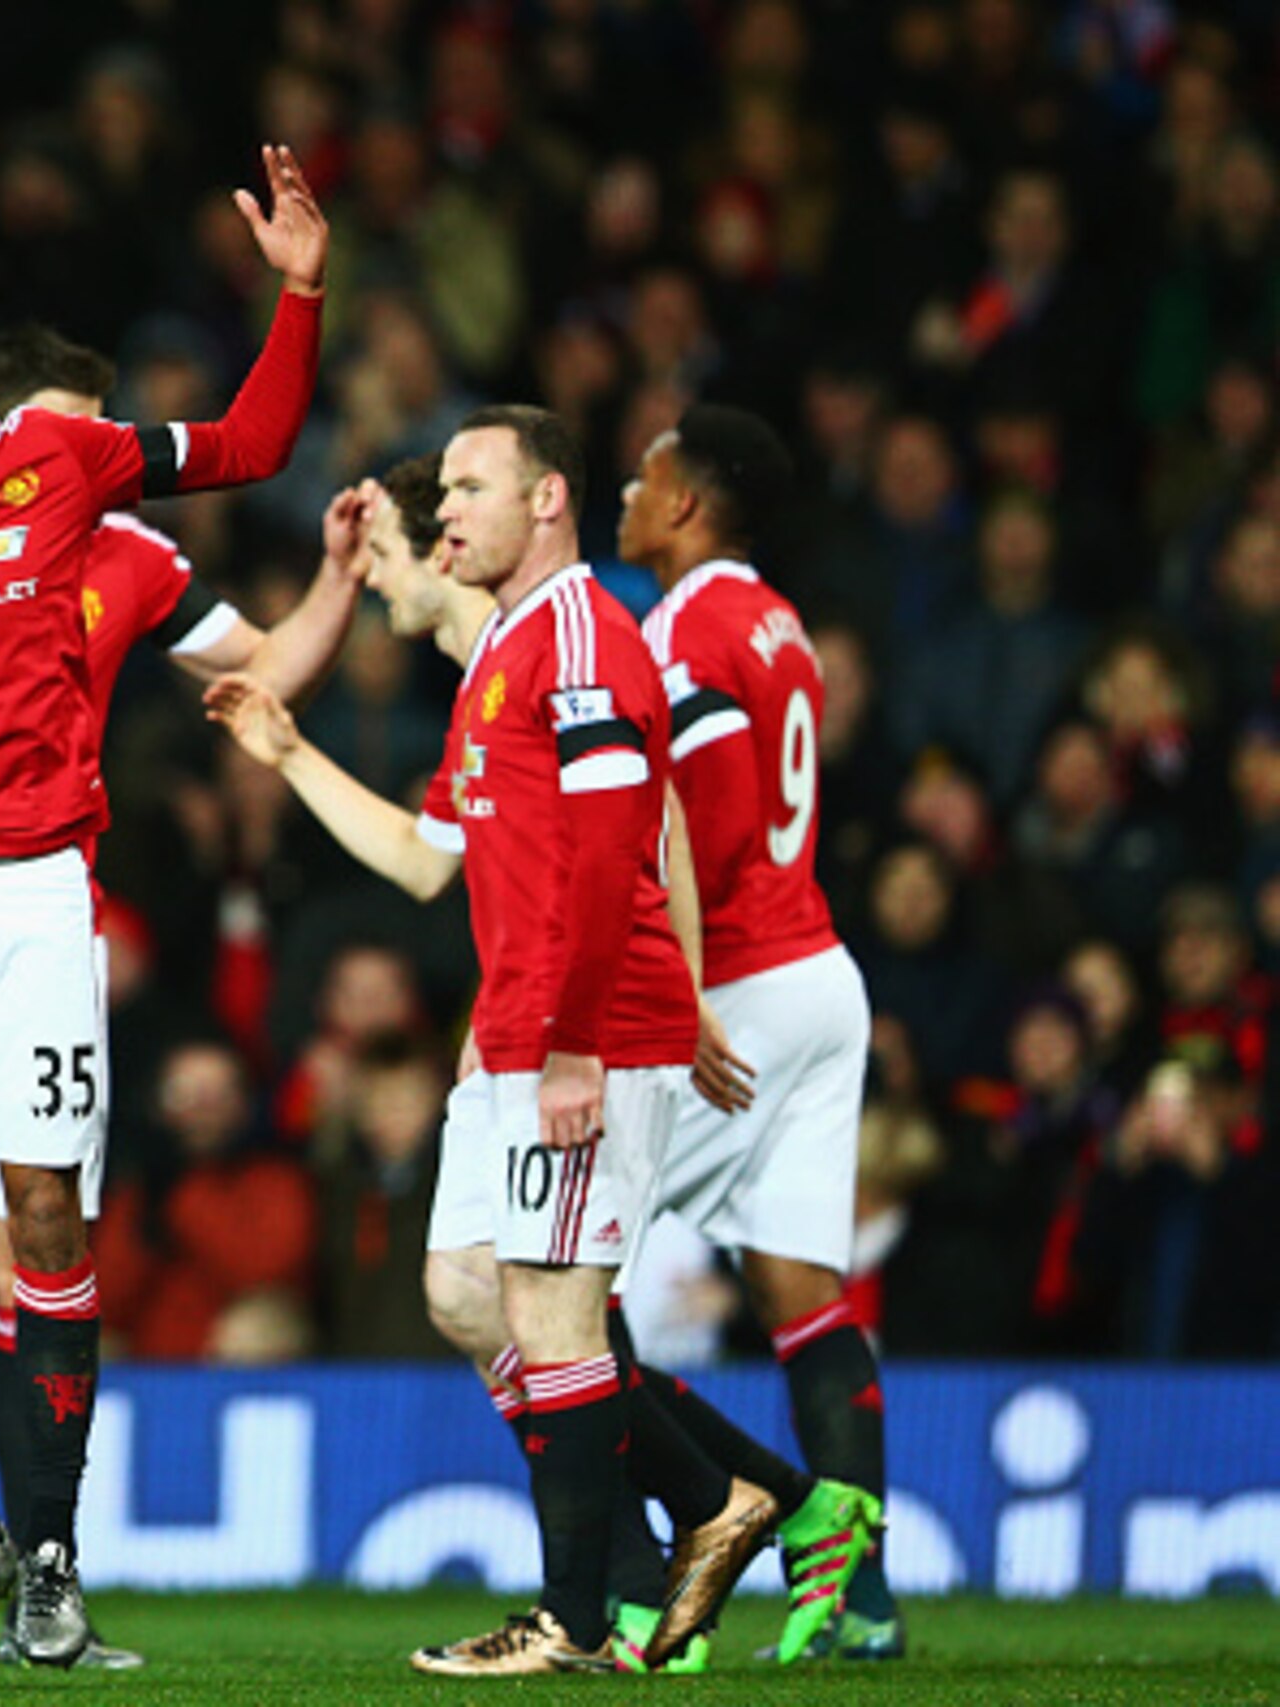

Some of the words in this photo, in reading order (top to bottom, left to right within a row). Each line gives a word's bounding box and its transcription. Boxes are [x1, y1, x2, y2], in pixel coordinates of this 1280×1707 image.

[768, 688, 817, 867] 9
[31, 1043, 96, 1118] 35
[507, 1143, 552, 1213] 10
